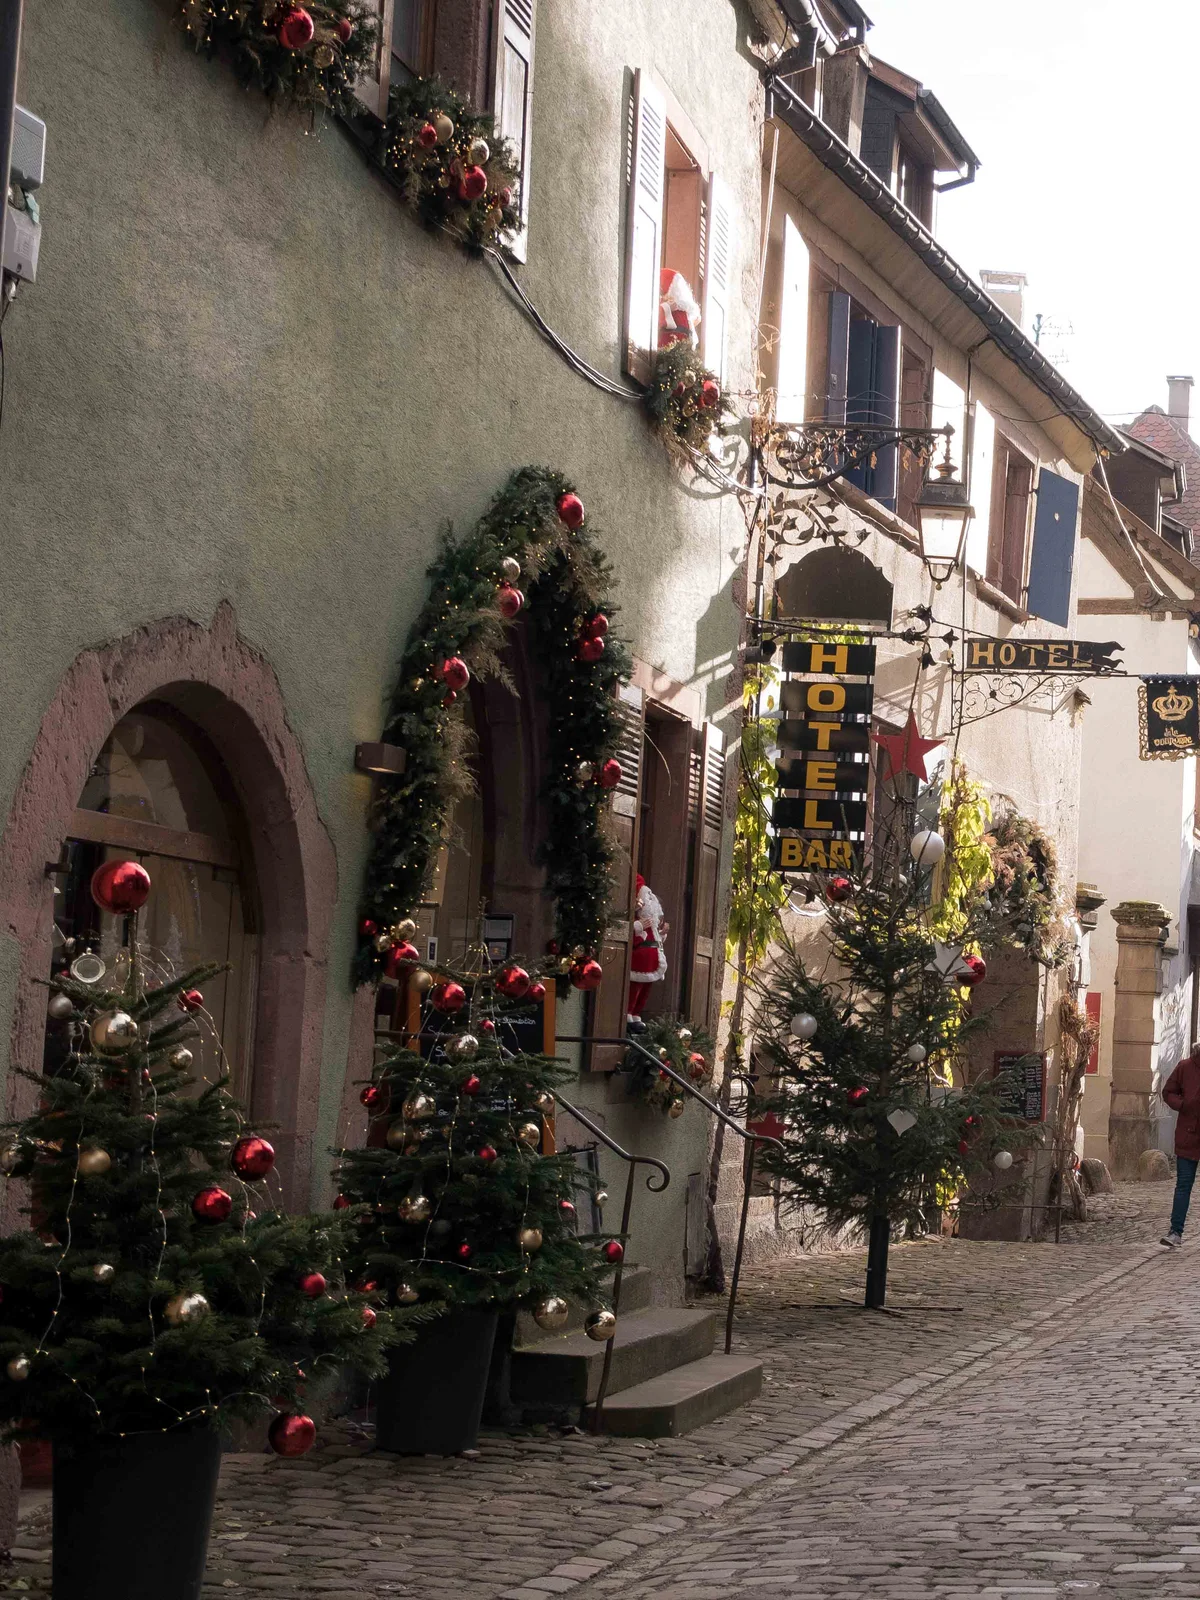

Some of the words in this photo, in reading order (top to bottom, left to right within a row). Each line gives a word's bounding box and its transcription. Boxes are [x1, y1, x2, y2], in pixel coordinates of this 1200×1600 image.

[972, 642, 1093, 668] HOTEL
[804, 644, 849, 829] HOTEL
[780, 838, 852, 870] BAR
